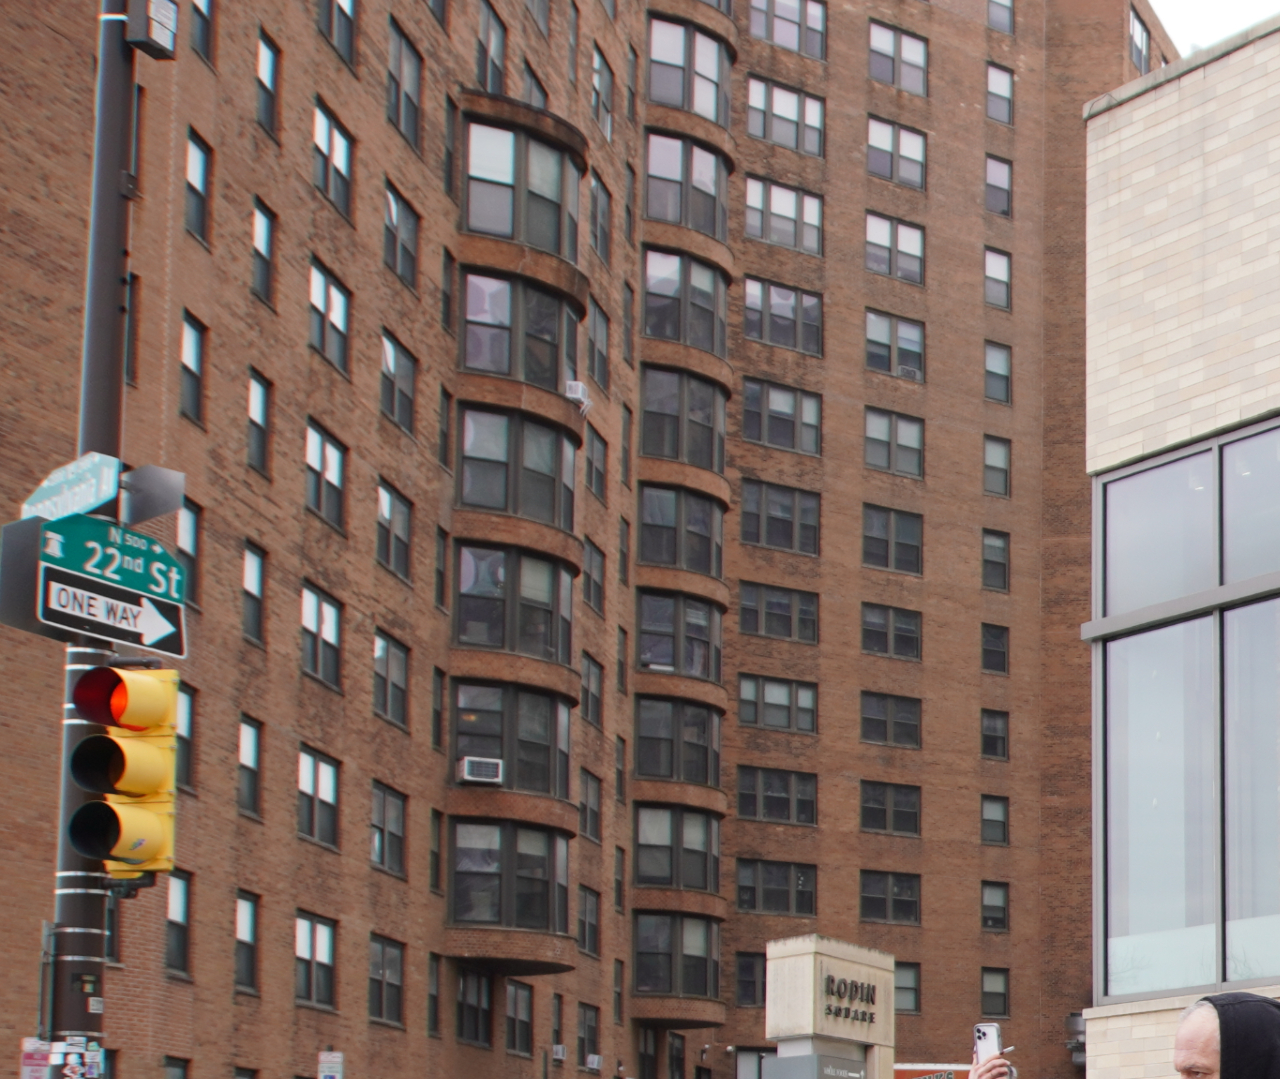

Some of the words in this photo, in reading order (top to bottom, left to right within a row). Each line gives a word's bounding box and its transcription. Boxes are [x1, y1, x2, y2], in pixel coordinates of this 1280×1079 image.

[108, 526, 122, 545] N
[124, 534, 148, 550] 500
[83, 540, 144, 582] 22nd
[148, 561, 182, 599] St
[57, 587, 98, 617] ONE
[105, 600, 142, 629] WAY
[825, 975, 876, 1005] RODIN
[825, 1004, 876, 1023] SQUARE
